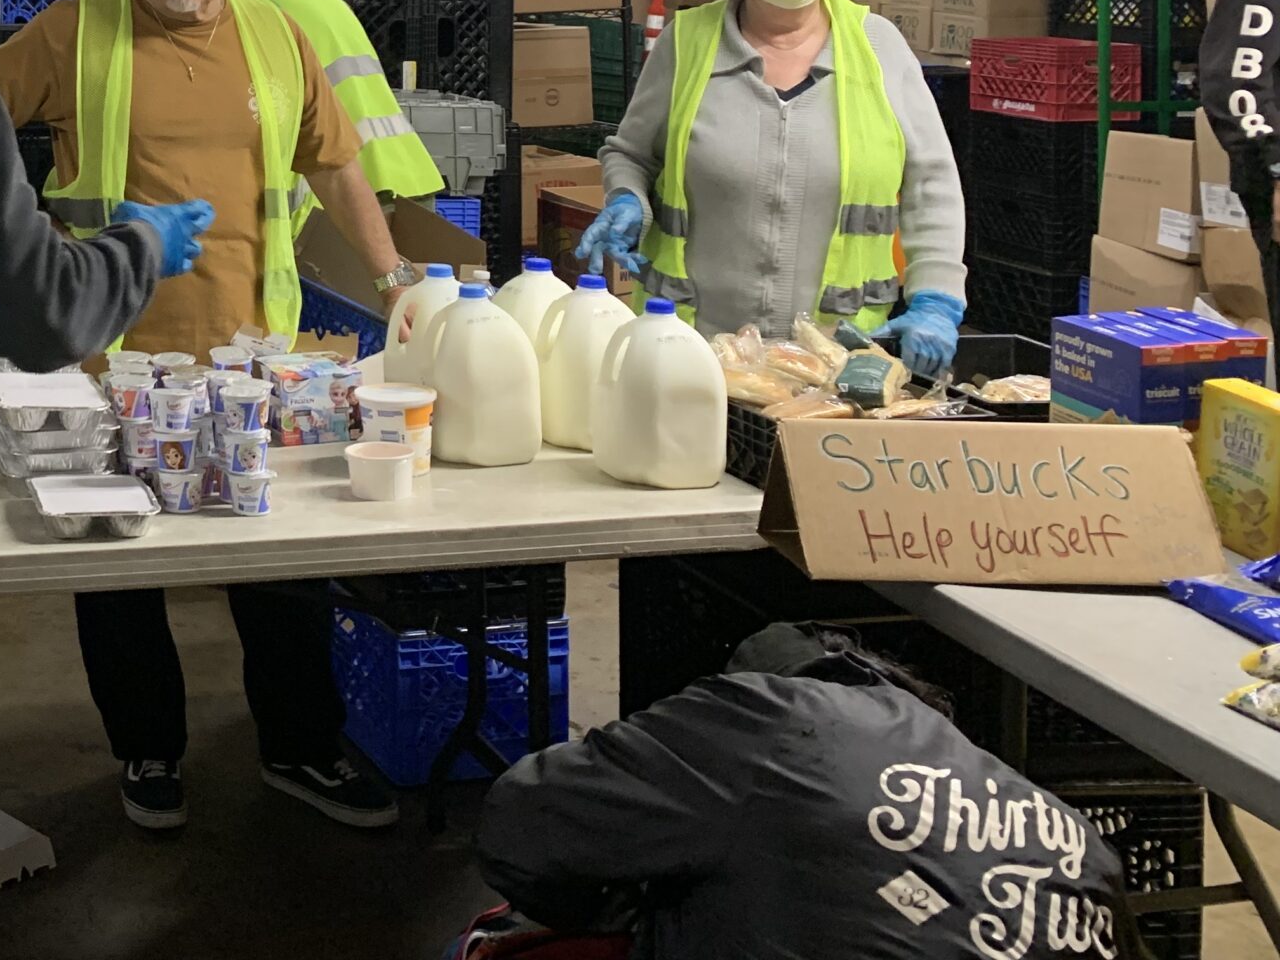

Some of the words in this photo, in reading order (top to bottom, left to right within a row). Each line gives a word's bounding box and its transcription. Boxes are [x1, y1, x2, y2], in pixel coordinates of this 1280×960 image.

[1054, 331, 1086, 351] proudly
[1086, 342, 1113, 359] grown
[1054, 345, 1061, 355] &
[1061, 348, 1087, 365] baked
[1087, 357, 1096, 368] in
[1054, 360, 1070, 374] the
[1071, 366, 1093, 383] USA
[1145, 386, 1181, 399] triscuit
[821, 433, 1131, 501] Starbucks
[857, 509, 953, 569] Help
[970, 513, 1129, 574] yourself
[867, 762, 1087, 880] Thirty
[897, 887, 930, 910] 32
[969, 863, 1120, 960] Two
